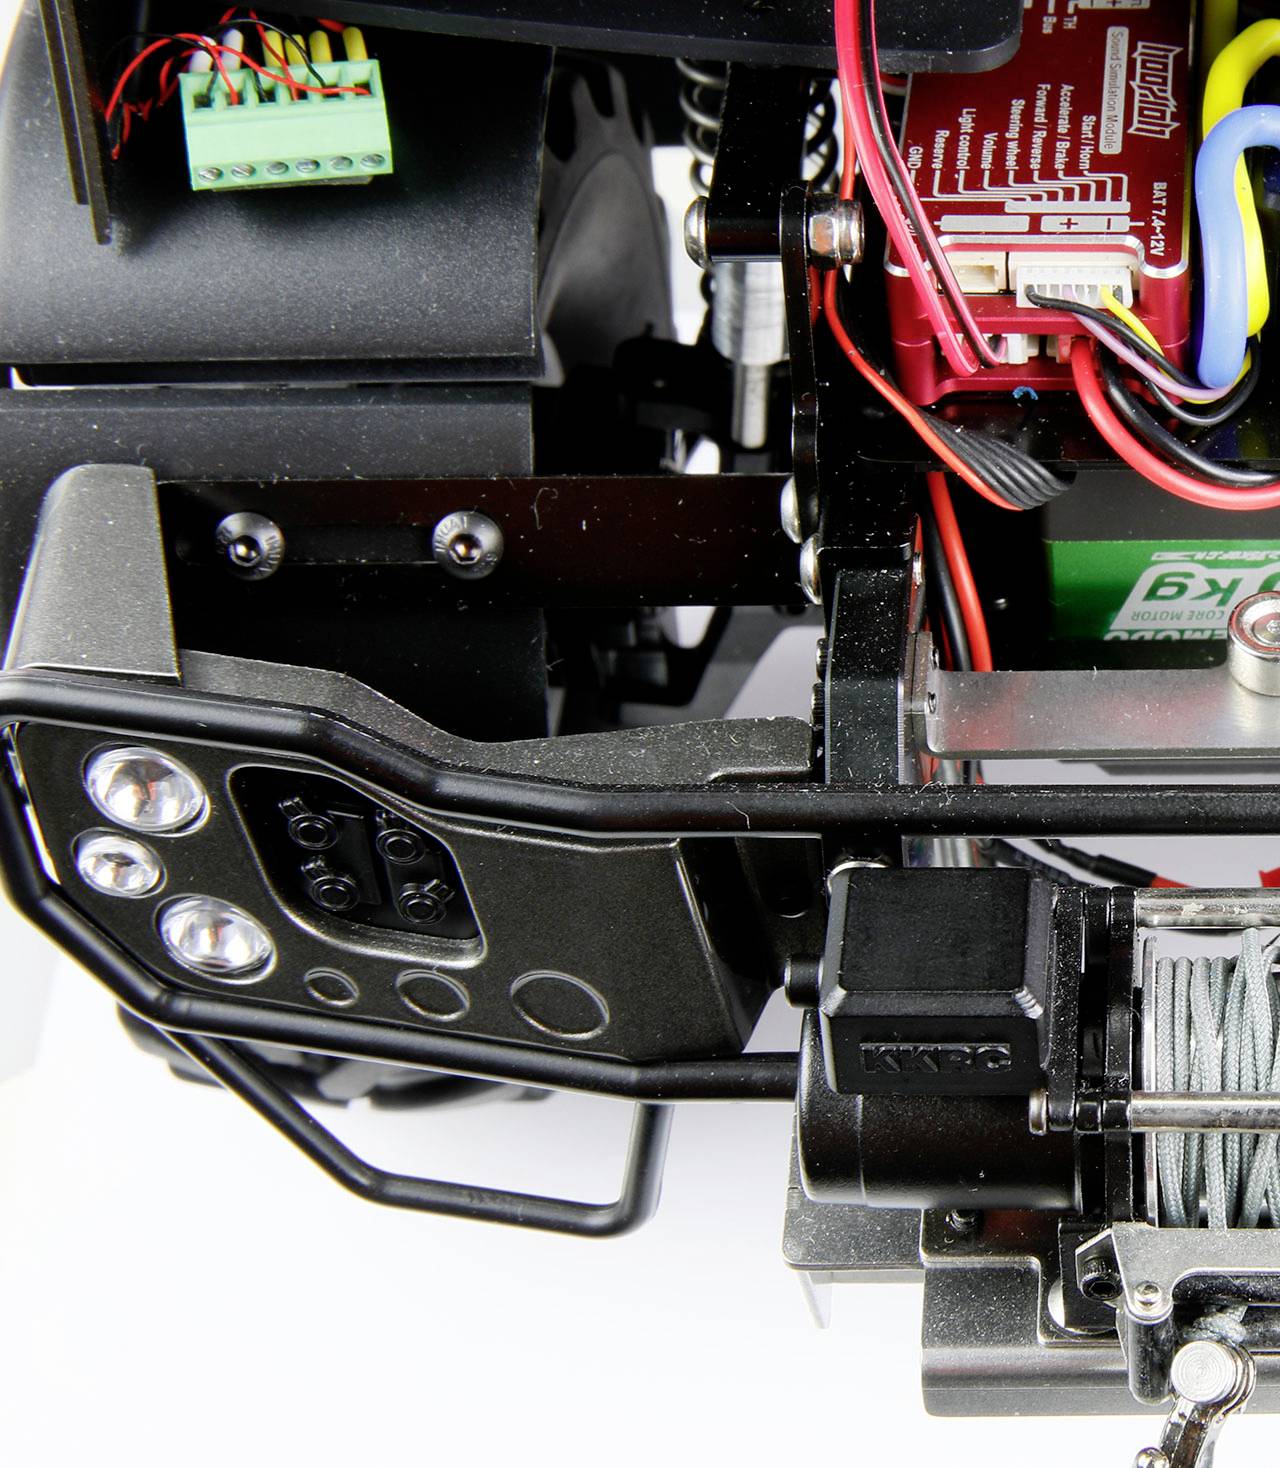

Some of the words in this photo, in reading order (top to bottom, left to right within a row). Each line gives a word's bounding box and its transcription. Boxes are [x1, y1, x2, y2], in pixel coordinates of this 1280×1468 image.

[1042, 15, 1057, 34] Bus
[1063, 15, 1078, 29] TH
[1110, 31, 1124, 61] Sound
[1104, 63, 1122, 112] Simulation
[1033, 83, 1051, 123] Forward
[1057, 83, 1075, 134] Accelerate
[958, 108, 977, 133] Light
[1005, 99, 1026, 139] Steering
[1081, 115, 1096, 139] Start
[1103, 114, 1119, 150] Module
[907, 146, 924, 169] GND
[931, 130, 951, 169] Reserve
[956, 134, 971, 170] control
[980, 132, 998, 170] Volume
[1005, 140, 1021, 170] wheel
[1029, 130, 1047, 170] Reverse
[1054, 140, 1071, 170] Brake
[1079, 145, 1094, 170] Horn
[1153, 181, 1168, 206] BAT
[1149, 208, 1167, 257] 7.4~12V
[1132, 610, 1182, 623] MOTOR
[1187, 610, 1225, 623] CORE
[859, 1042, 1012, 1074] KKRC
